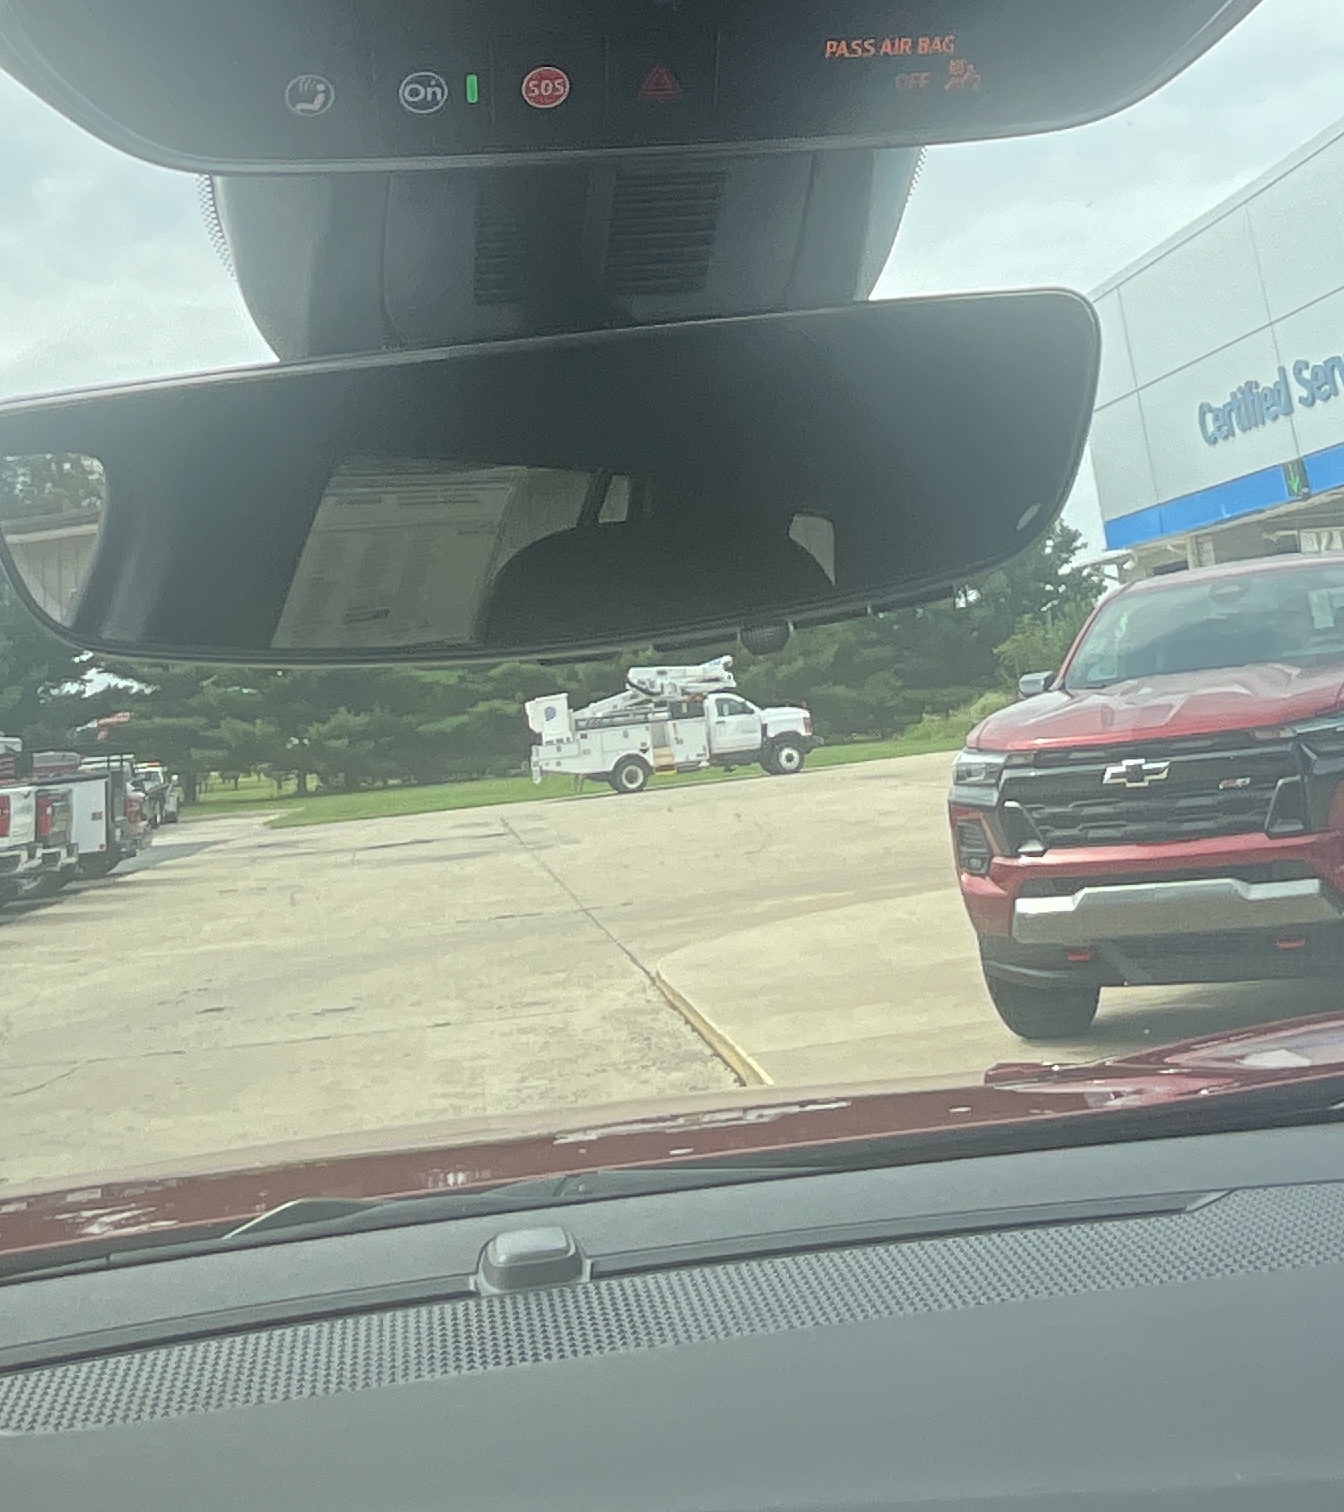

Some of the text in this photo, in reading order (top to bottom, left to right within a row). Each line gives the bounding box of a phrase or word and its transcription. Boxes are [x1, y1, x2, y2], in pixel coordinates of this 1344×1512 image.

[825, 35, 956, 58] PASS AIR BAG
[405, 80, 442, 102] On
[528, 78, 565, 98] SOS
[1198, 364, 1295, 446] Certified
